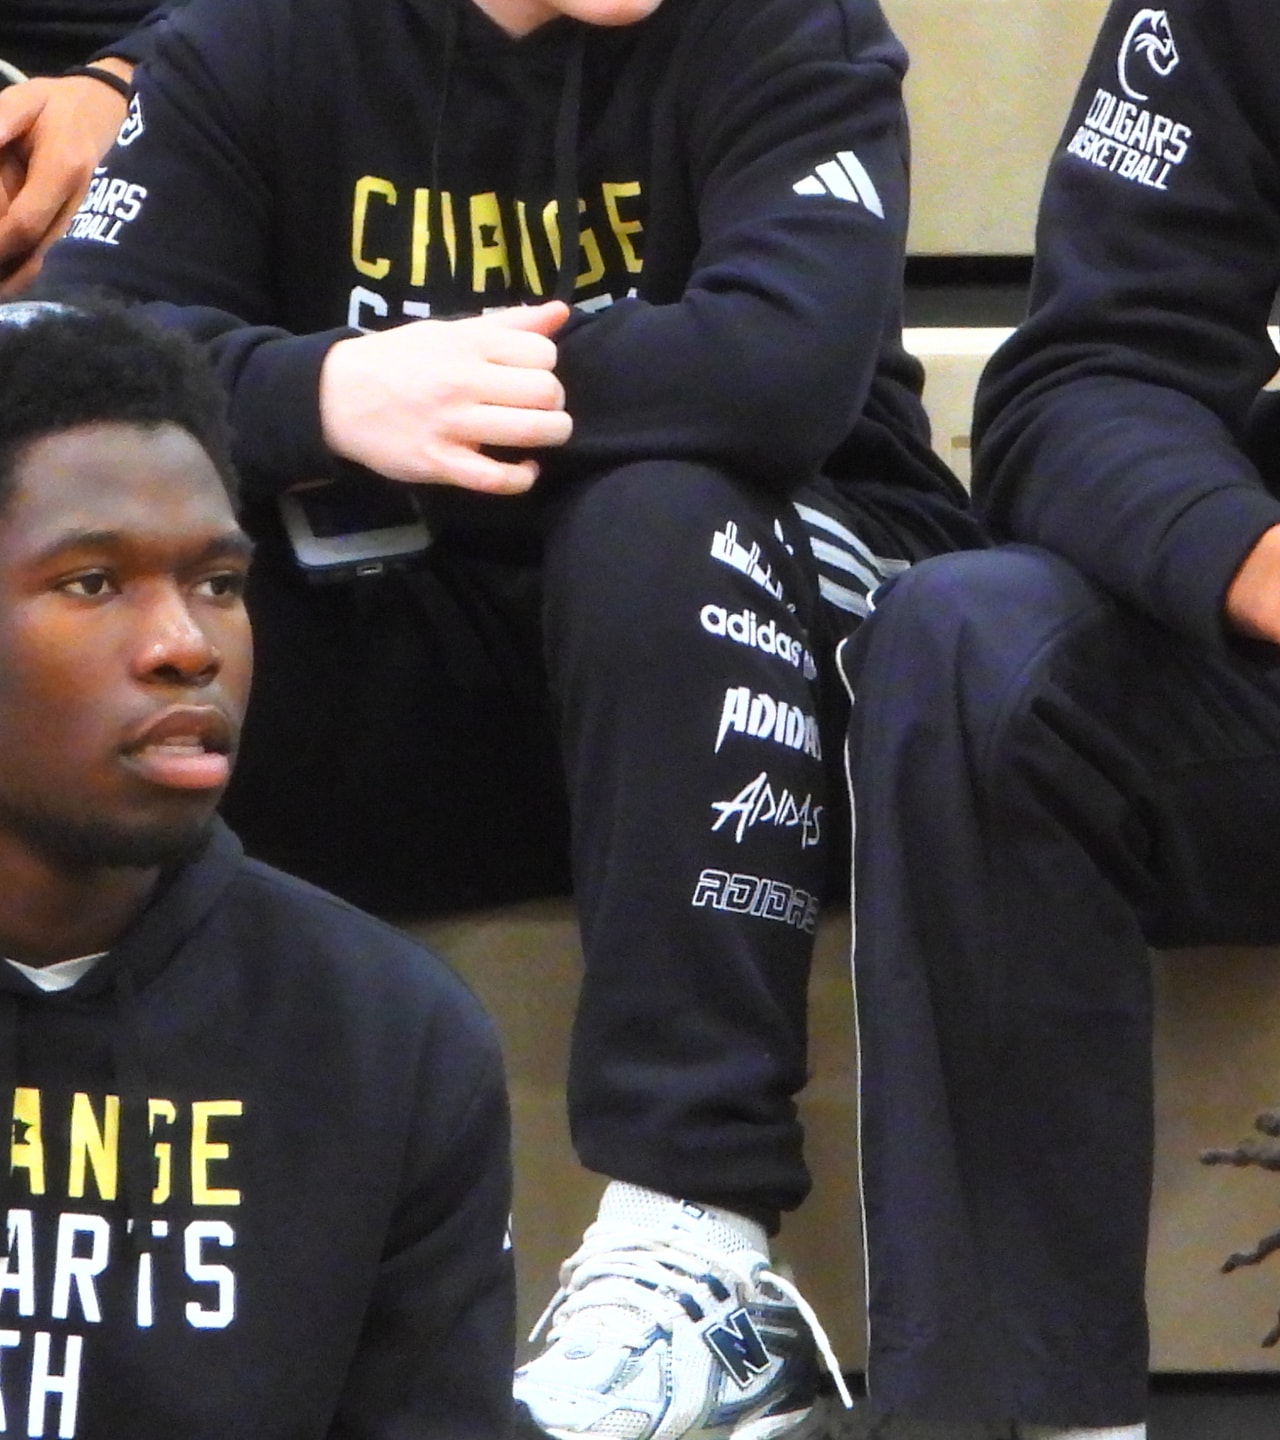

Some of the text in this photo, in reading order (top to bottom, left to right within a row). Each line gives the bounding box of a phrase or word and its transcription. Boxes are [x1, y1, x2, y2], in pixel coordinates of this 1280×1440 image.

[1085, 88, 1192, 164] COUGARS
[67, 213, 122, 245] TBALL
[77, 177, 147, 221] GARS
[700, 604, 802, 668] adidas
[714, 686, 821, 761] ADIDA
